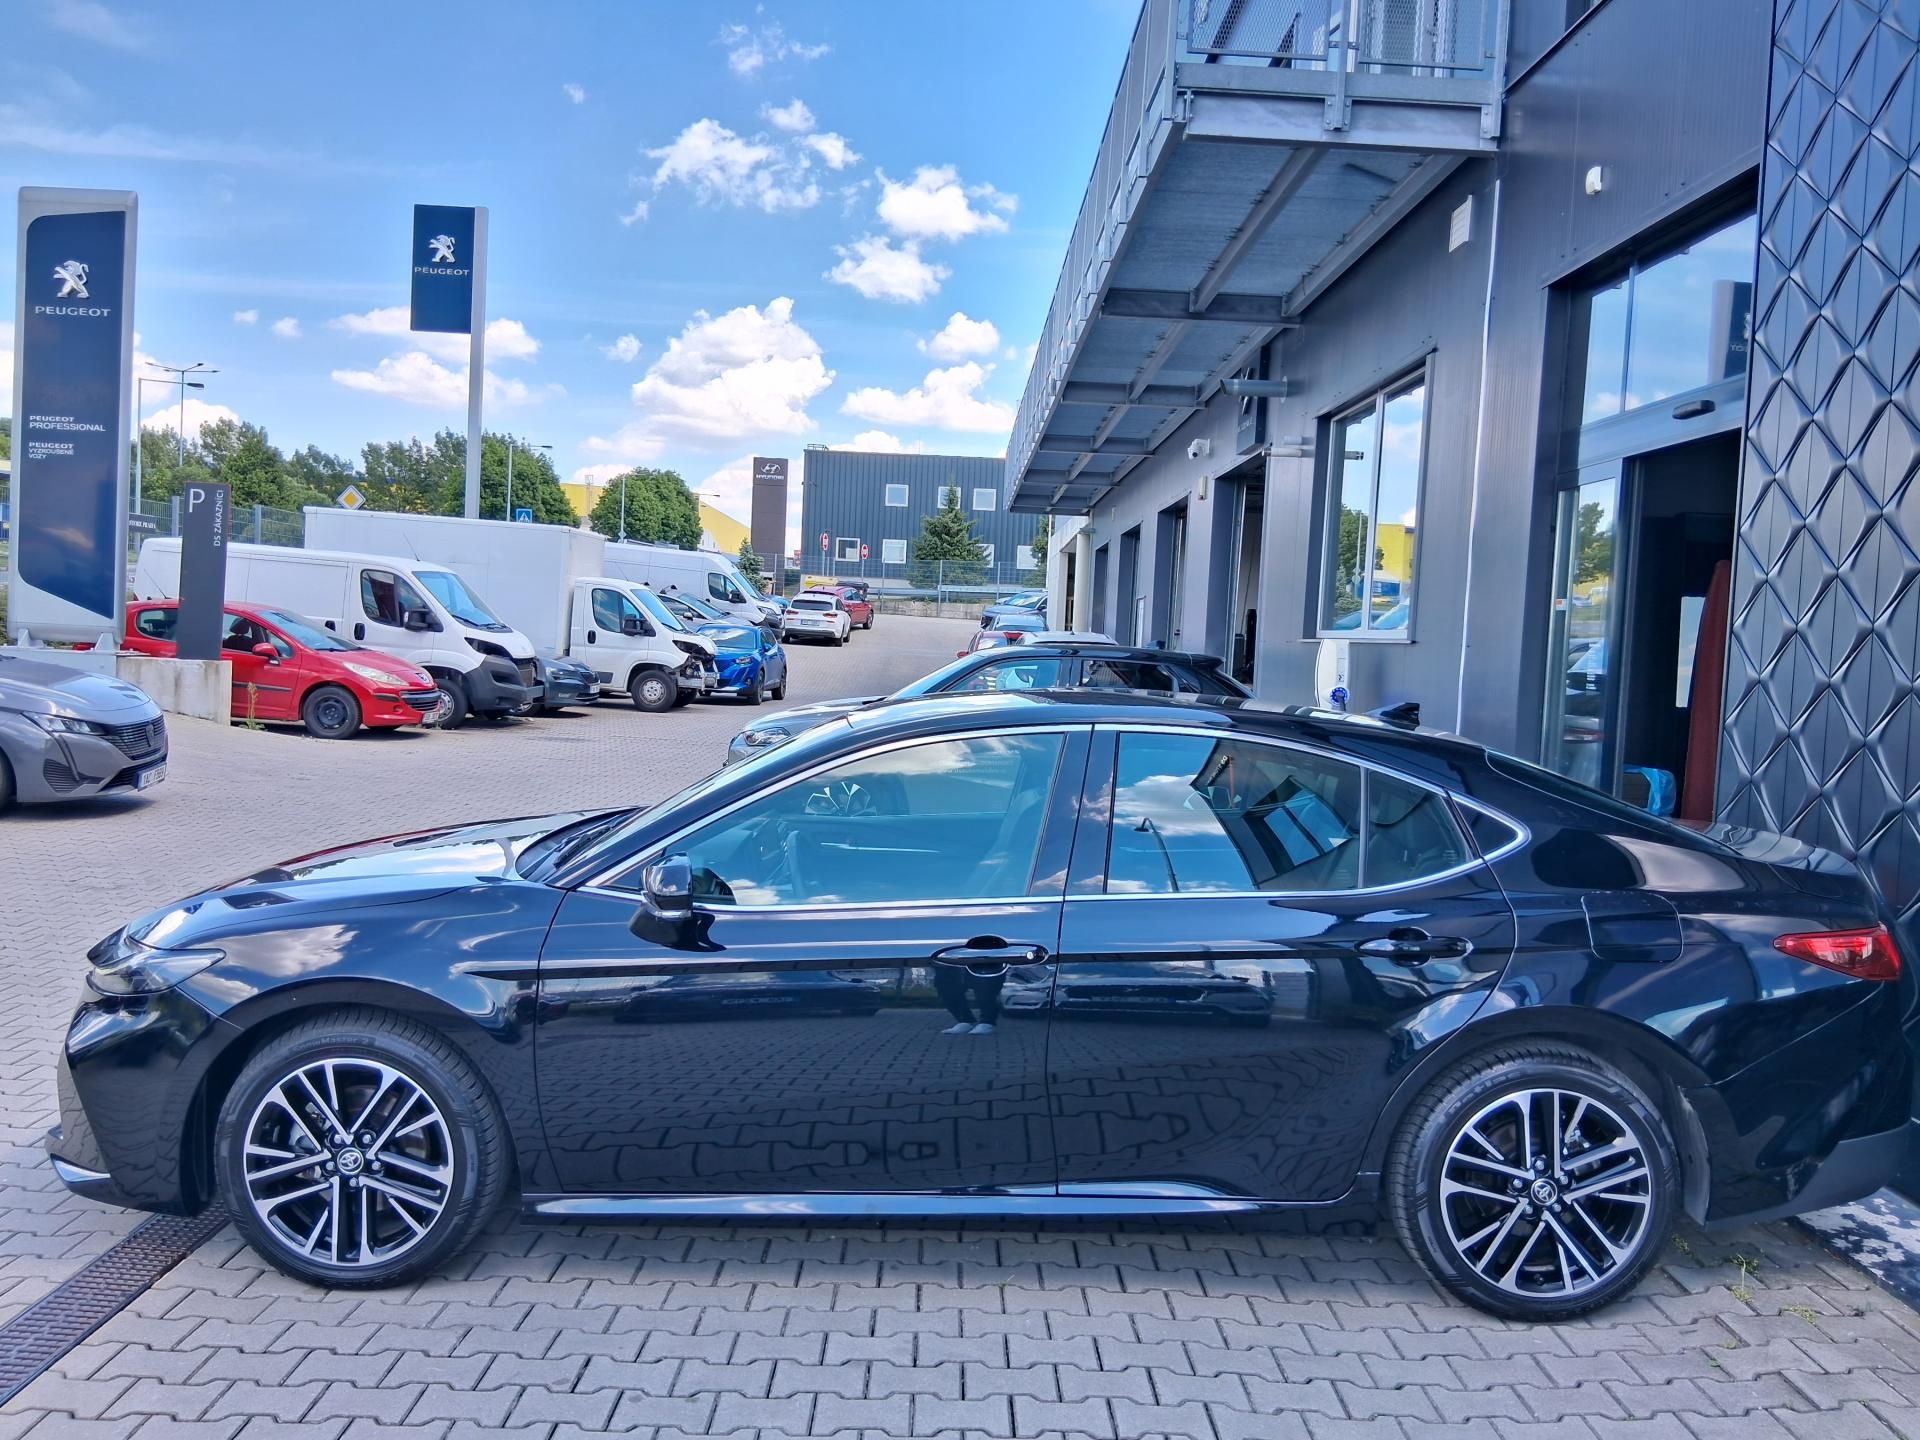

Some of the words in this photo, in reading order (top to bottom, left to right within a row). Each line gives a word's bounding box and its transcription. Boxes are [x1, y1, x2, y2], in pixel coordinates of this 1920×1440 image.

[414, 266, 470, 276] PEUGEOT
[35, 306, 111, 317] PEUGEOT
[29, 422, 106, 432] PROFESSIONAL
[28, 441, 74, 449] PEUGEOT
[189, 488, 205, 513] P
[213, 535, 221, 547] DS
